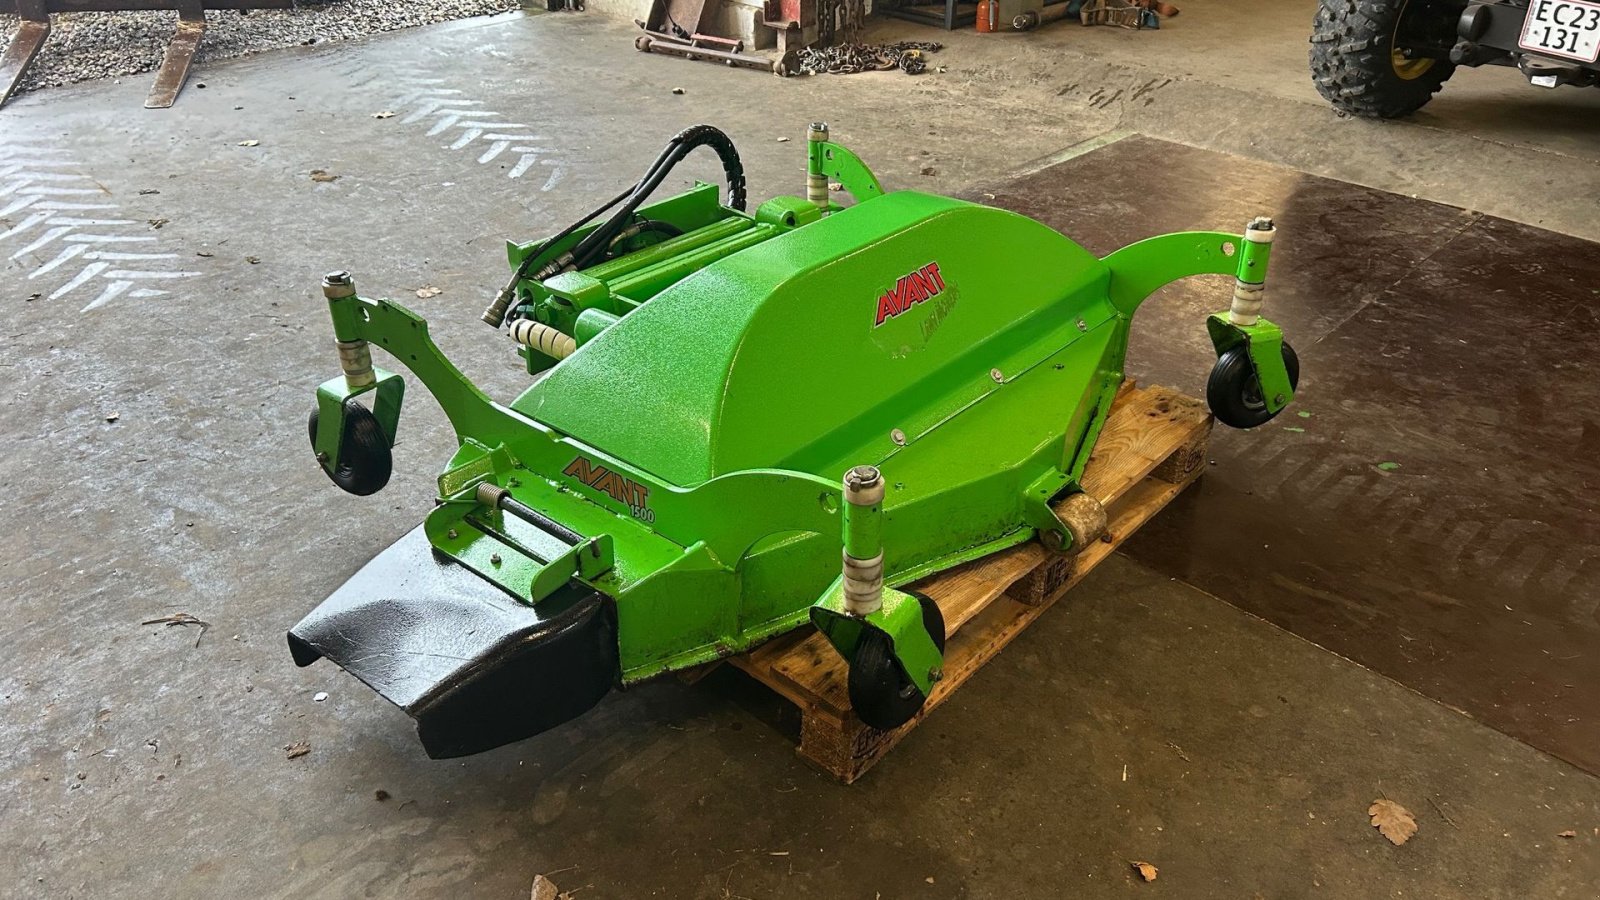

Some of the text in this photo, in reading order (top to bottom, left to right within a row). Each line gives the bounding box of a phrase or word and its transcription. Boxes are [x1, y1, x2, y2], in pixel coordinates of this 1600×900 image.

[1536, 0, 1600, 31] EC23
[1539, 26, 1579, 53] 131
[874, 261, 945, 328] AVANT
[562, 456, 649, 509] AVANT
[629, 504, 656, 523] 1500
